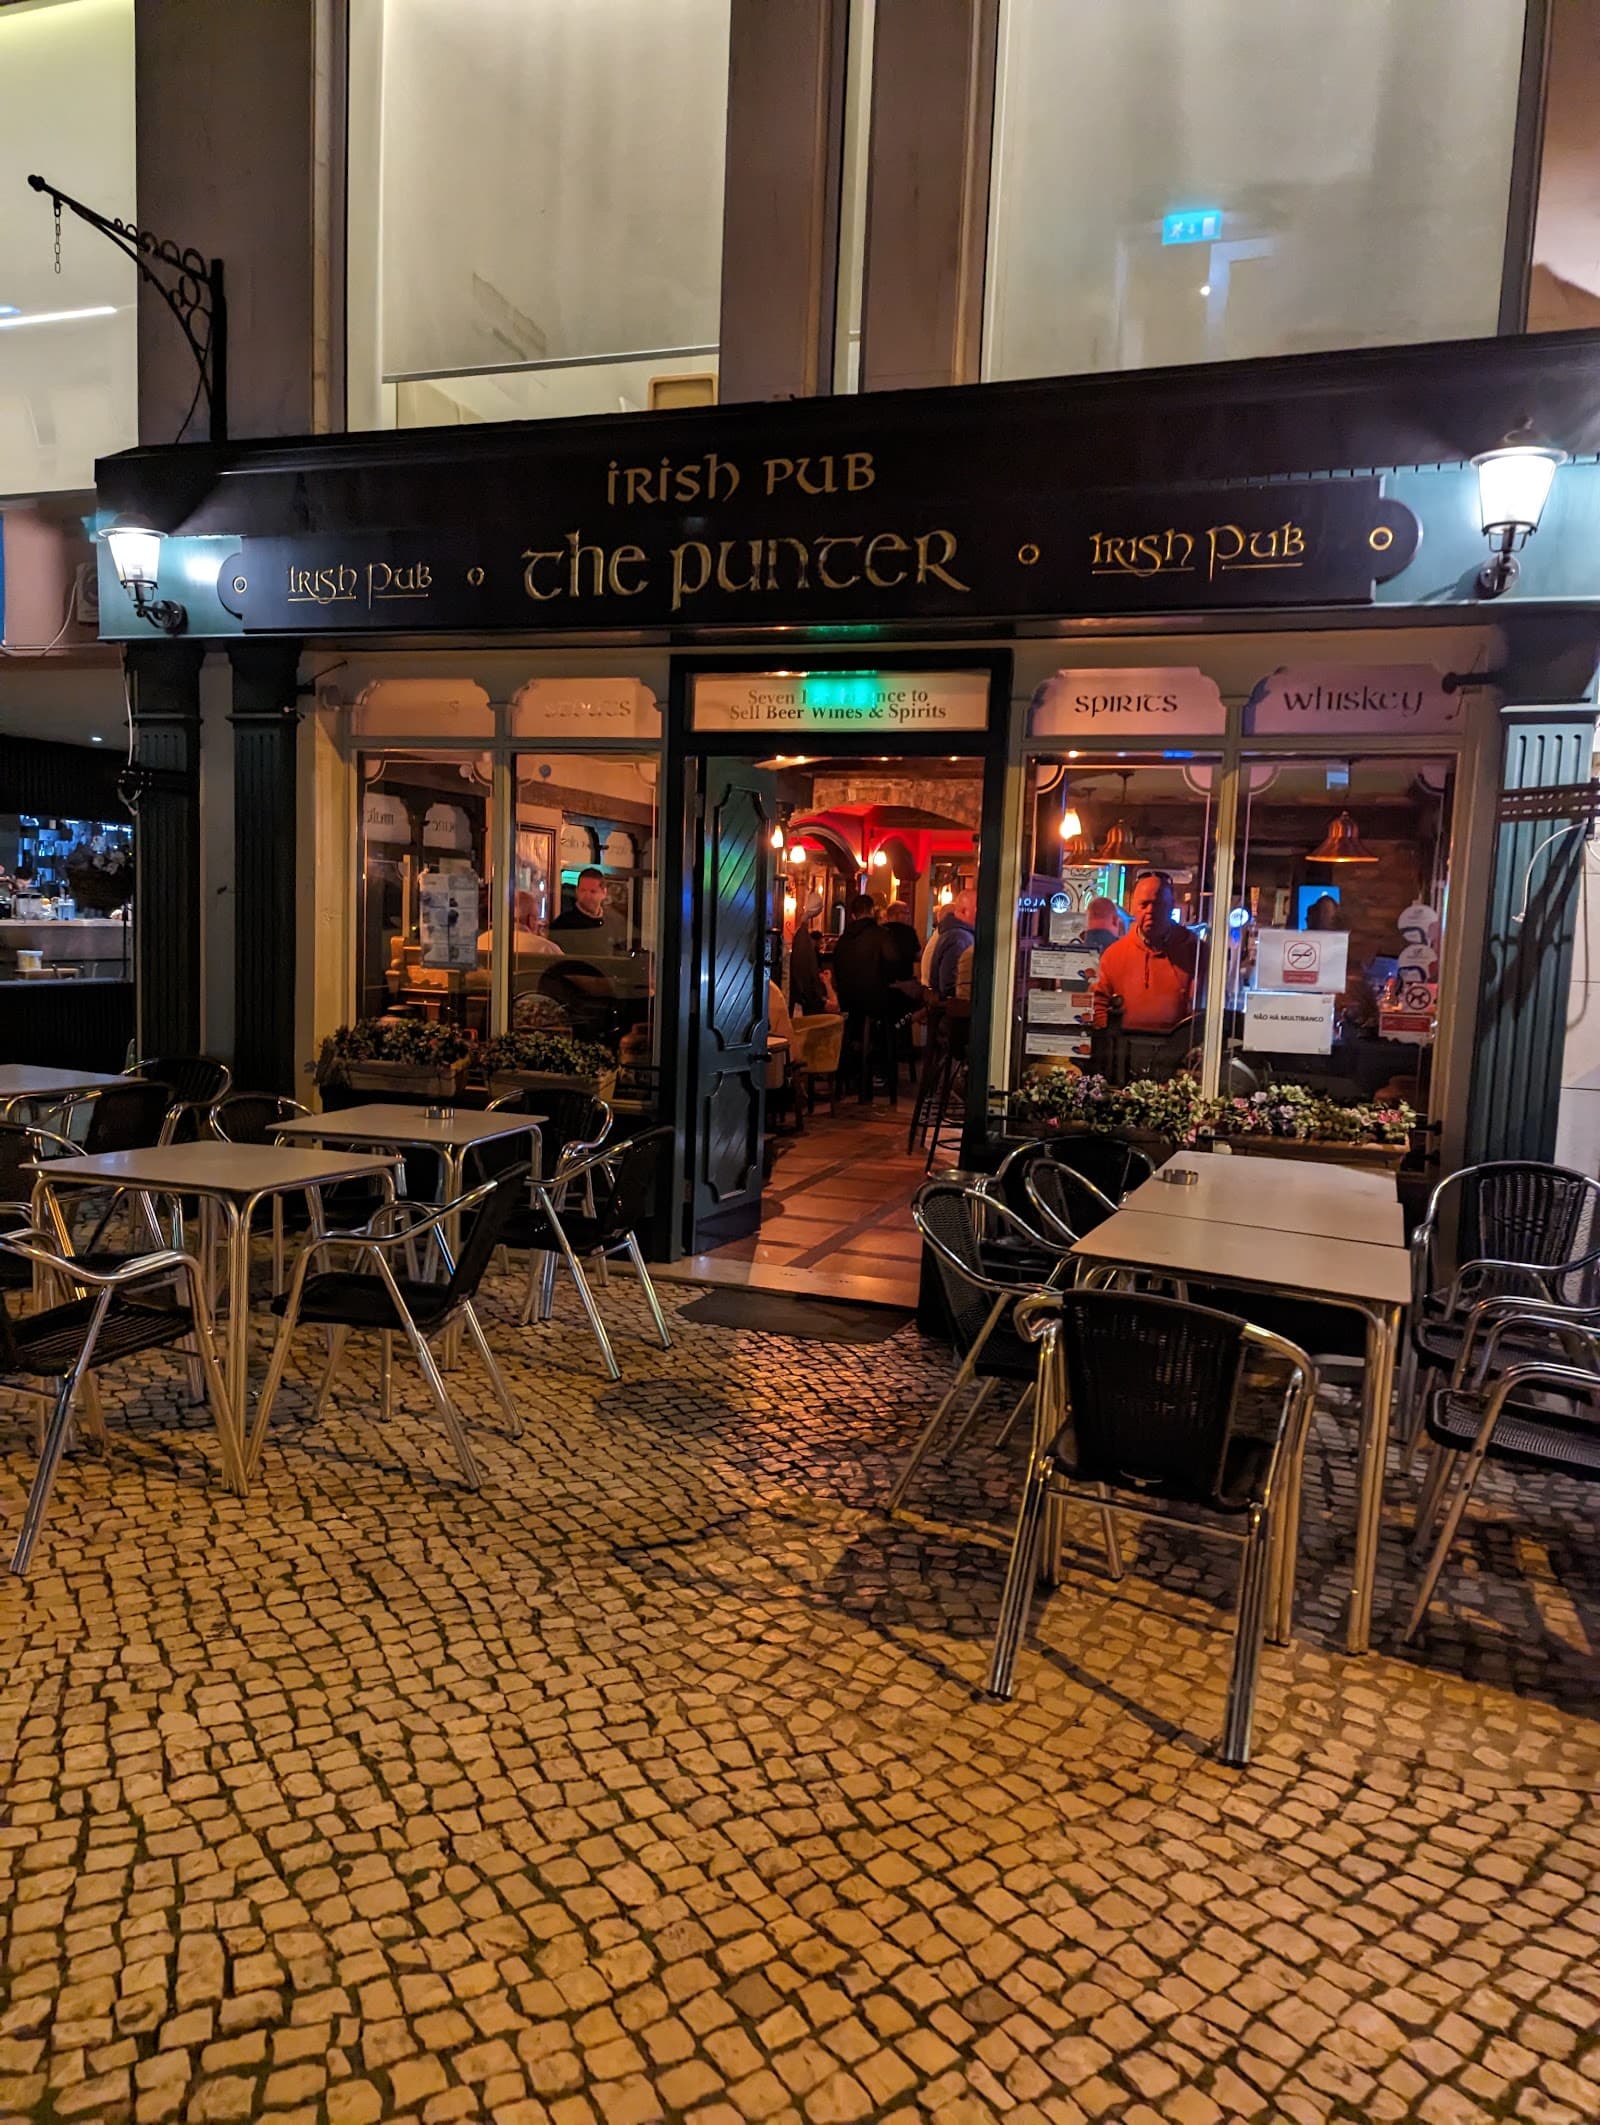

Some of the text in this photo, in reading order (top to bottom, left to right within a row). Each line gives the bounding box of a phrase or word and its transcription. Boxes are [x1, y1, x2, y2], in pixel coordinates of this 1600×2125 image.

[747, 689, 796, 706] Seven
[911, 689, 929, 703] to
[729, 703, 947, 724] Sell Beer Wines & Spirits
[1280, 1014, 1325, 1023] MULTIBANCO
